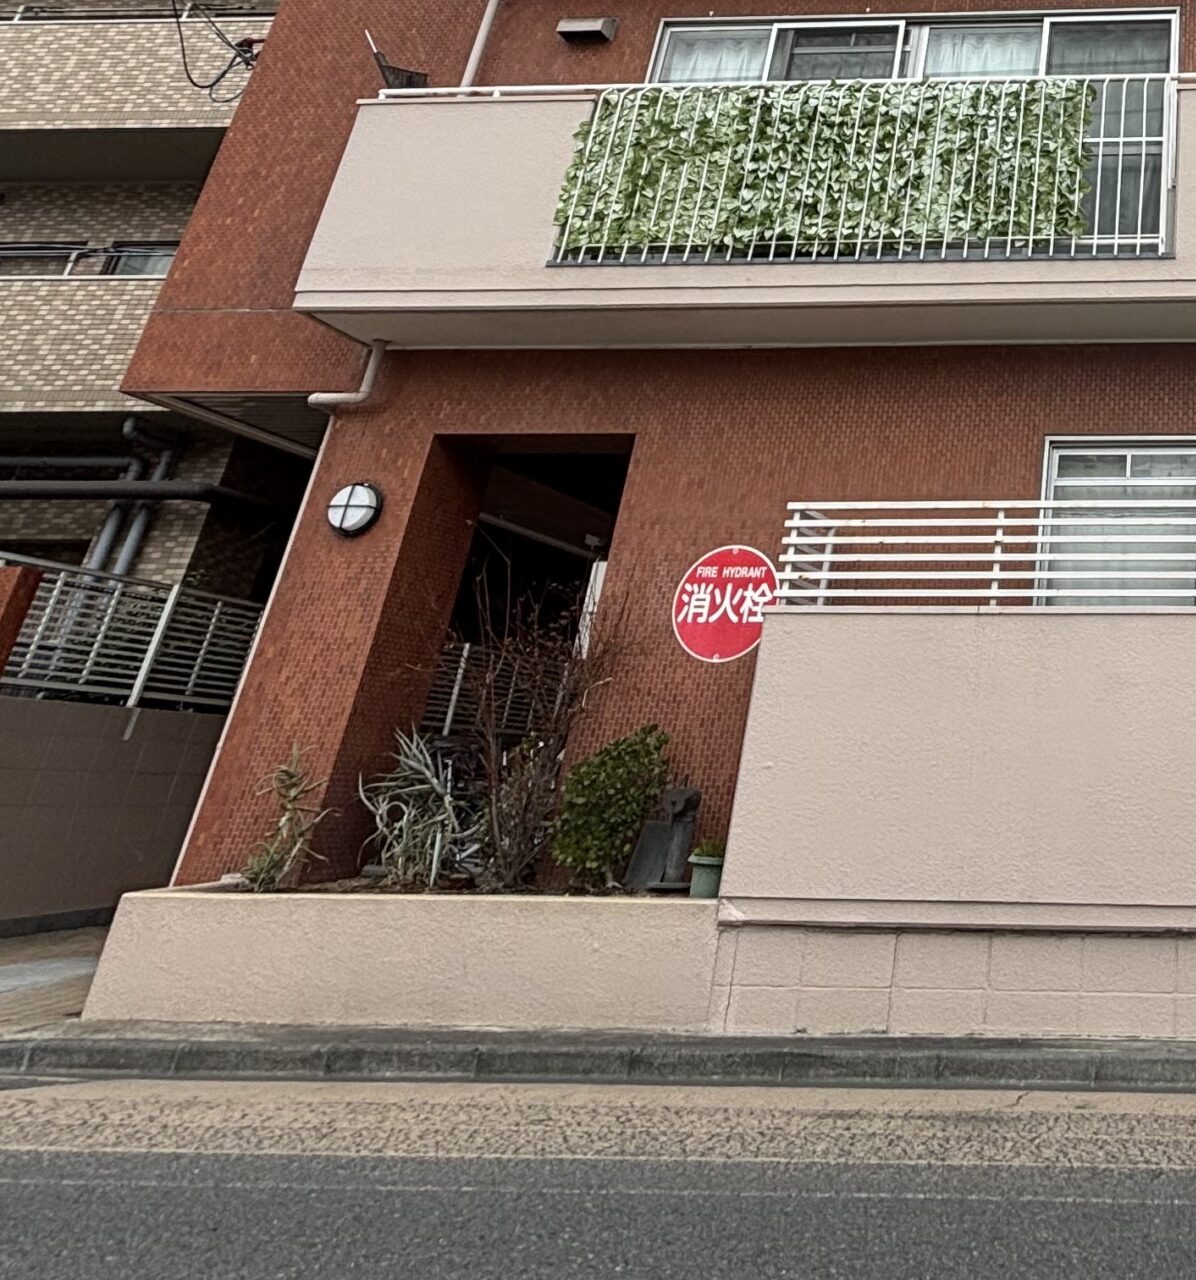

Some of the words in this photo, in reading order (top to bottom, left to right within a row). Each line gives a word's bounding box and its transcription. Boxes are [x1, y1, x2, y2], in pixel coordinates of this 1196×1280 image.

[696, 566, 718, 578] FIRE
[722, 566, 767, 578] HYDRANT
[677, 582, 773, 624] 消火栓
